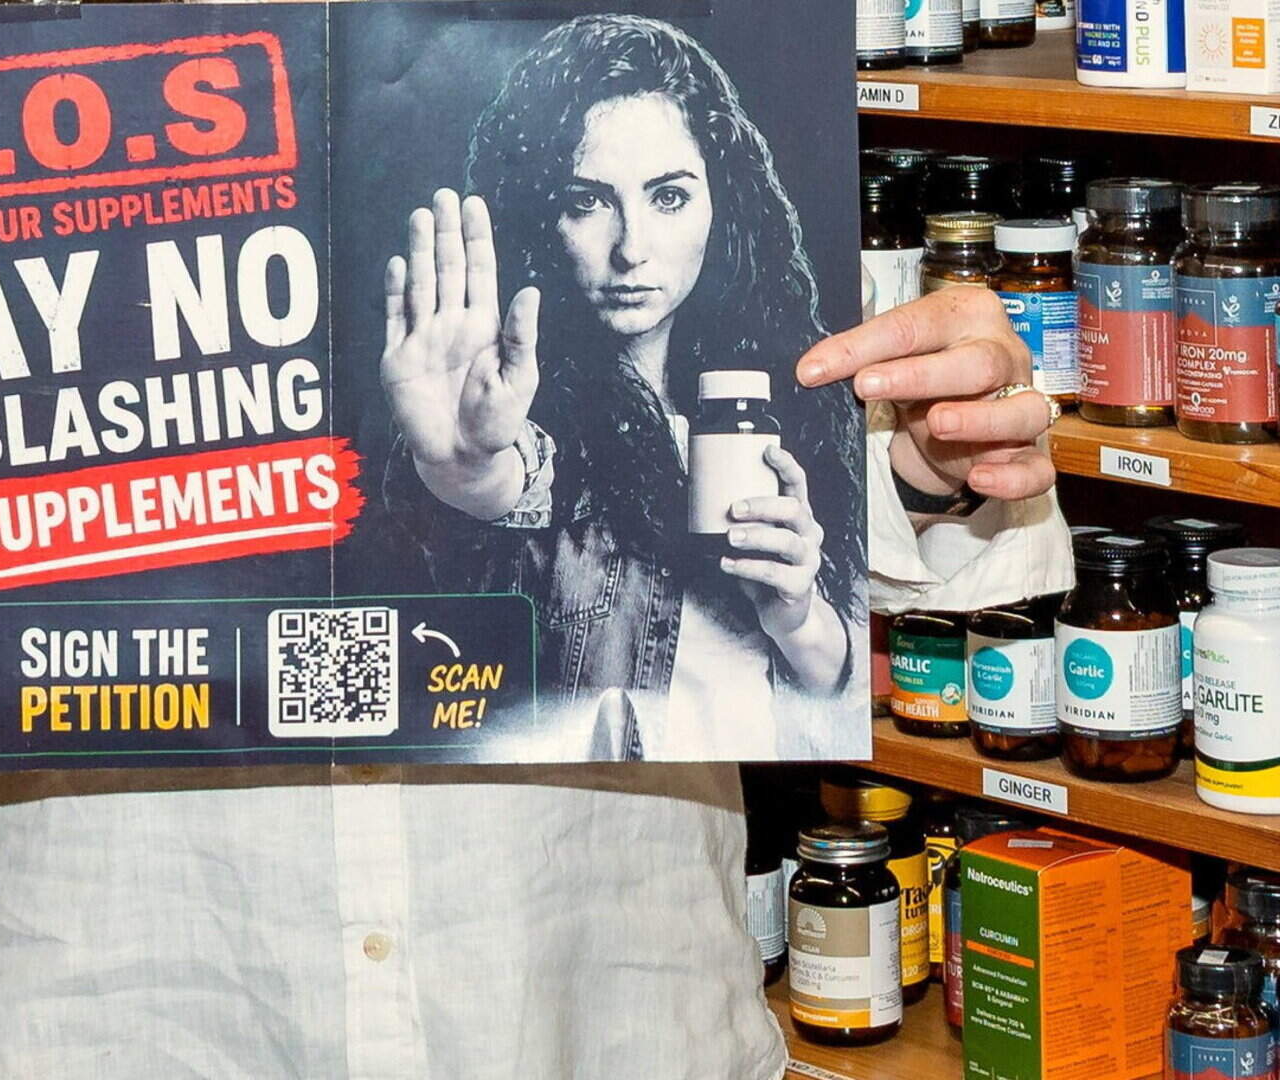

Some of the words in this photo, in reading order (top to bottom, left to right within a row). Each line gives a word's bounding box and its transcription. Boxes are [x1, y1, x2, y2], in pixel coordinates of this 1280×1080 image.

[52, 176, 298, 237] SUPPLEMENTS
[147, 225, 319, 360] NO
[1117, 456, 1153, 476] IRON
[20, 626, 118, 678] SIGN
[132, 628, 209, 675] THE
[427, 662, 504, 694] SCAN
[1068, 663, 1105, 679] Garlic
[21, 682, 210, 733] PETITION
[432, 698, 487, 730] ME!
[1064, 704, 1116, 721] VIRIDIAN
[1198, 687, 1264, 715] GARLITE
[998, 778, 1052, 804] GINGER
[979, 927, 1019, 947] CURCUMIN
